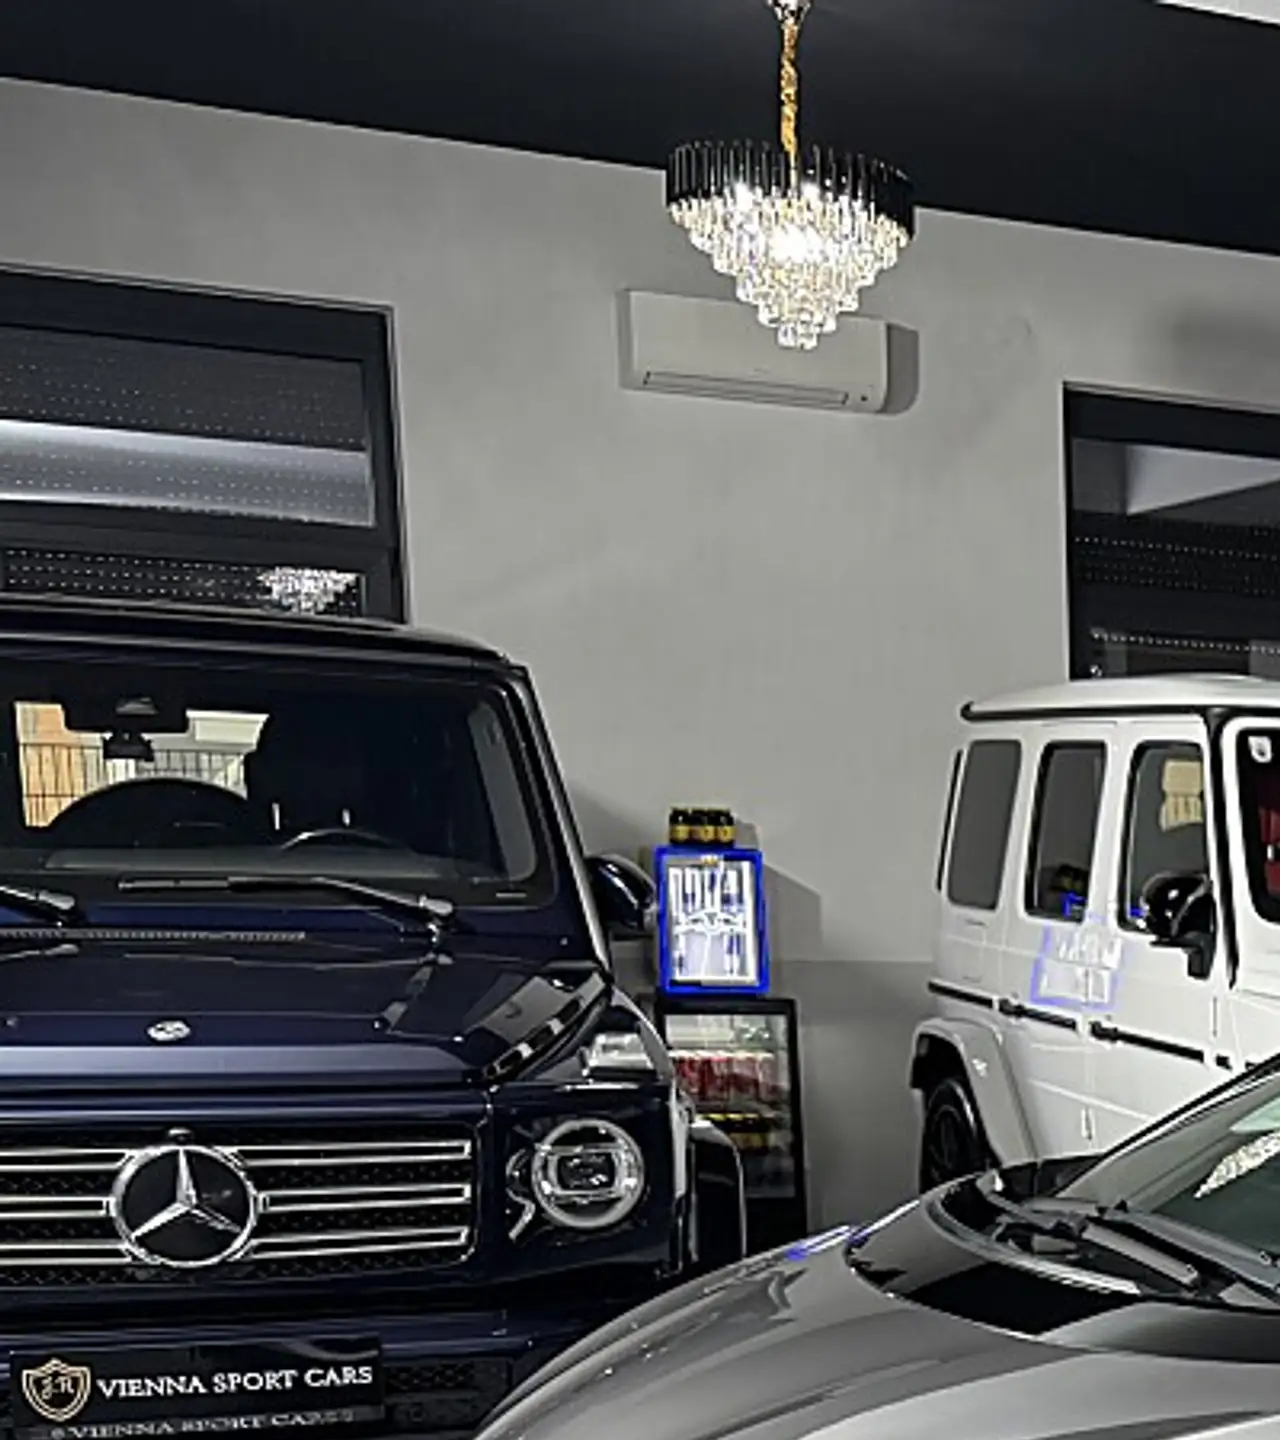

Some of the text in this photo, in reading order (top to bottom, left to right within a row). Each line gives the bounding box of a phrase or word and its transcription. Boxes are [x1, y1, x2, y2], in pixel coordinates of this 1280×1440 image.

[96, 1366, 373, 1399] VIENNA SPORT CARS
